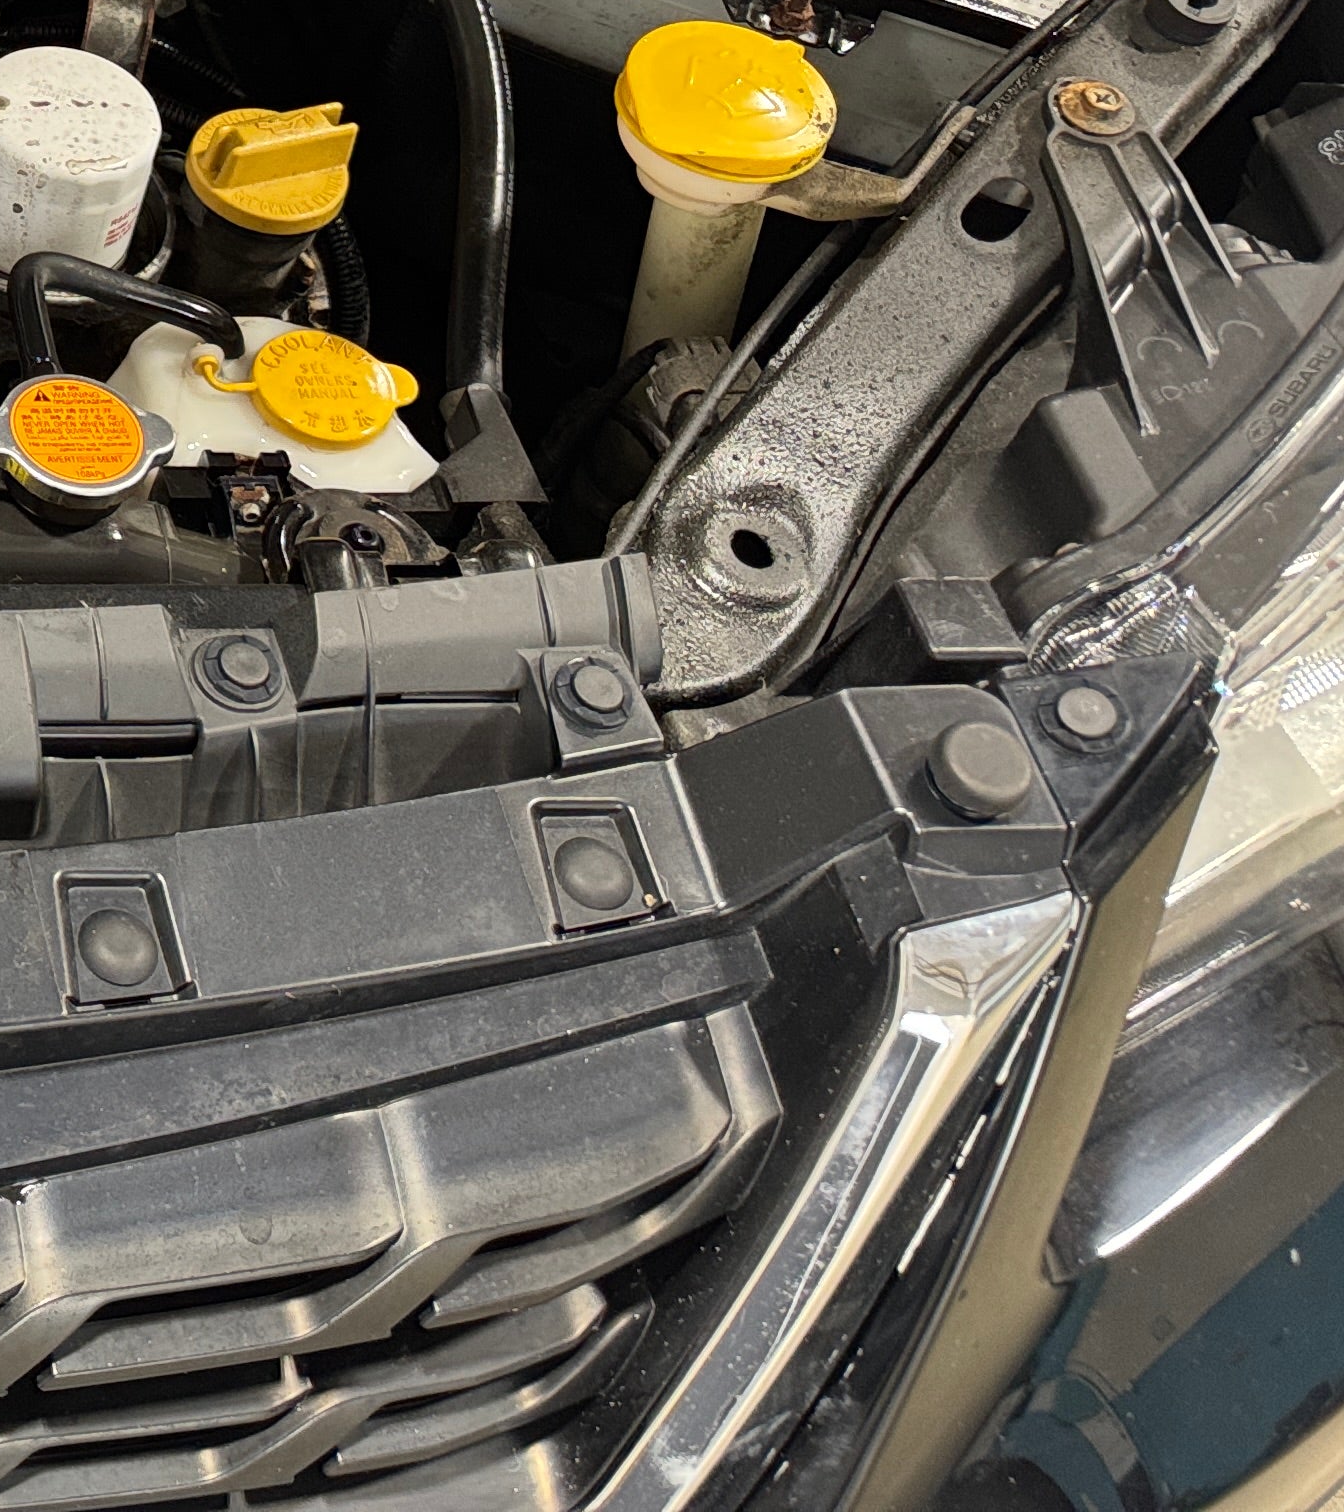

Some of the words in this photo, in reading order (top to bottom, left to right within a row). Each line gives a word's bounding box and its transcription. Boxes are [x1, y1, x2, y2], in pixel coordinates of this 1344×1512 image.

[260, 334, 372, 369] COOLANT
[299, 362, 330, 374] SEE
[1269, 344, 1336, 418] SUBARU
[298, 388, 359, 400] MANUAL
[48, 455, 123, 463] AVERTISSEMENT
